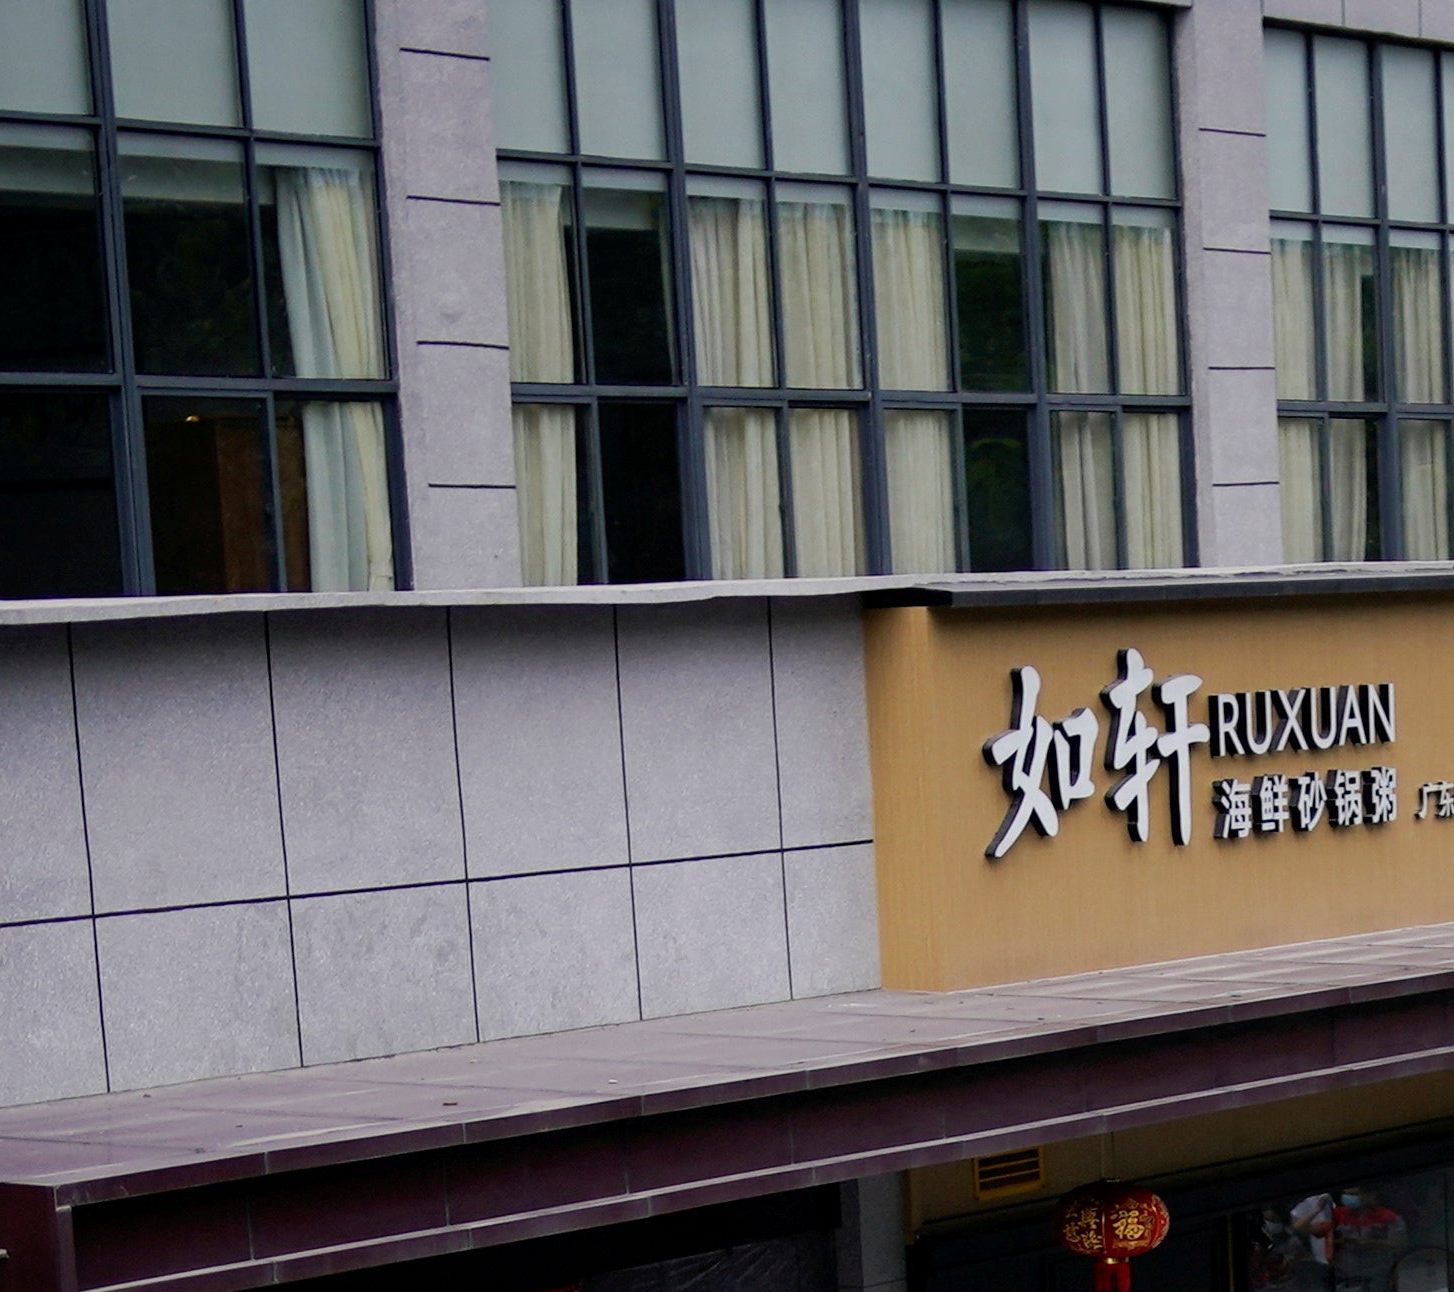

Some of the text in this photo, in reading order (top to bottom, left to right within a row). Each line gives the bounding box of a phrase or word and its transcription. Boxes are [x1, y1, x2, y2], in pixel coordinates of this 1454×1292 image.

[983, 648, 1210, 859] 如轩
[1210, 682, 1397, 756] RUXUAN
[1214, 768, 1399, 840] 海鲜砂锅粥
